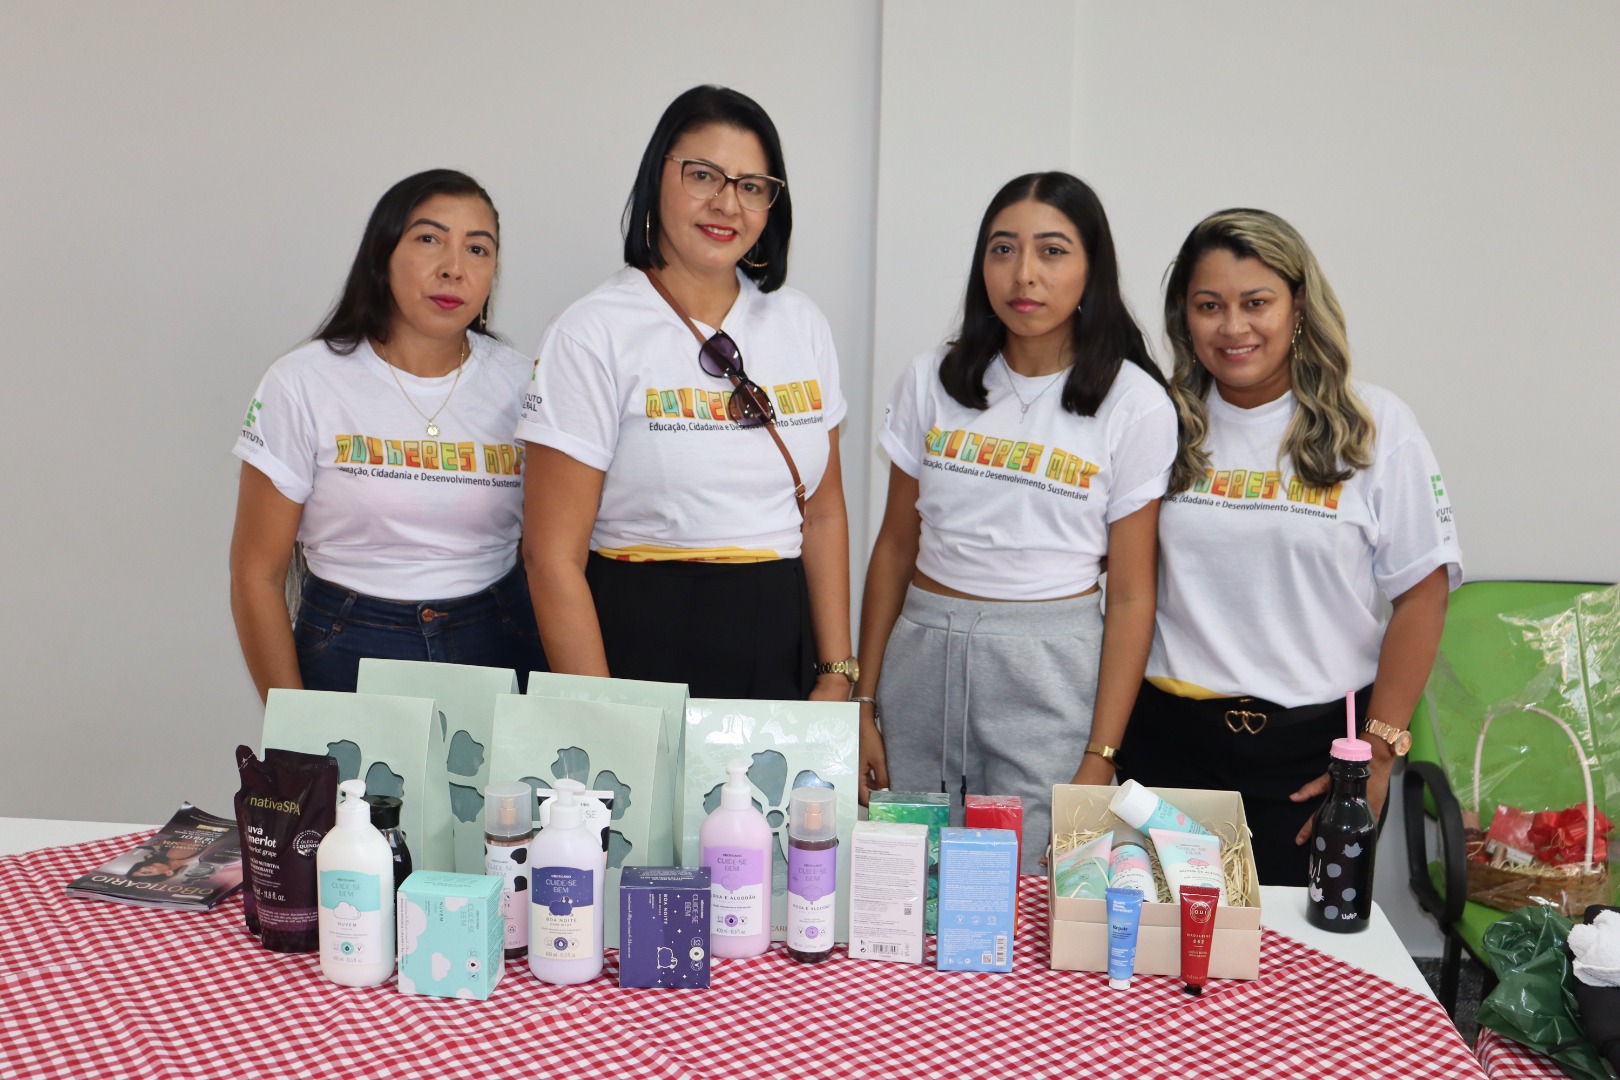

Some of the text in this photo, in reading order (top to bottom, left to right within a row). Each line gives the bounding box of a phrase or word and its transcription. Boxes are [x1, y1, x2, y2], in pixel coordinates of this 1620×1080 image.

[649, 422, 688, 432] Educação,
[689, 421, 724, 431] Cidadania
[789, 415, 824, 427] Sustentável
[371, 467, 412, 480] Cidadania
[421, 472, 491, 487] Desenvolvimento
[944, 462, 979, 477] Cidadania
[985, 471, 1046, 490] Desenvolvimento
[1047, 483, 1089, 501] Sustentável
[1222, 500, 1289, 512] Desenvolvimento
[1290, 505, 1337, 520] Sustentável
[250, 797, 301, 816] nativaSPA
[248, 825, 264, 836] uva
[248, 834, 277, 848] merlot
[262, 849, 278, 858] grape
[553, 886, 569, 894] BEM
[684, 901, 692, 917] BEM
